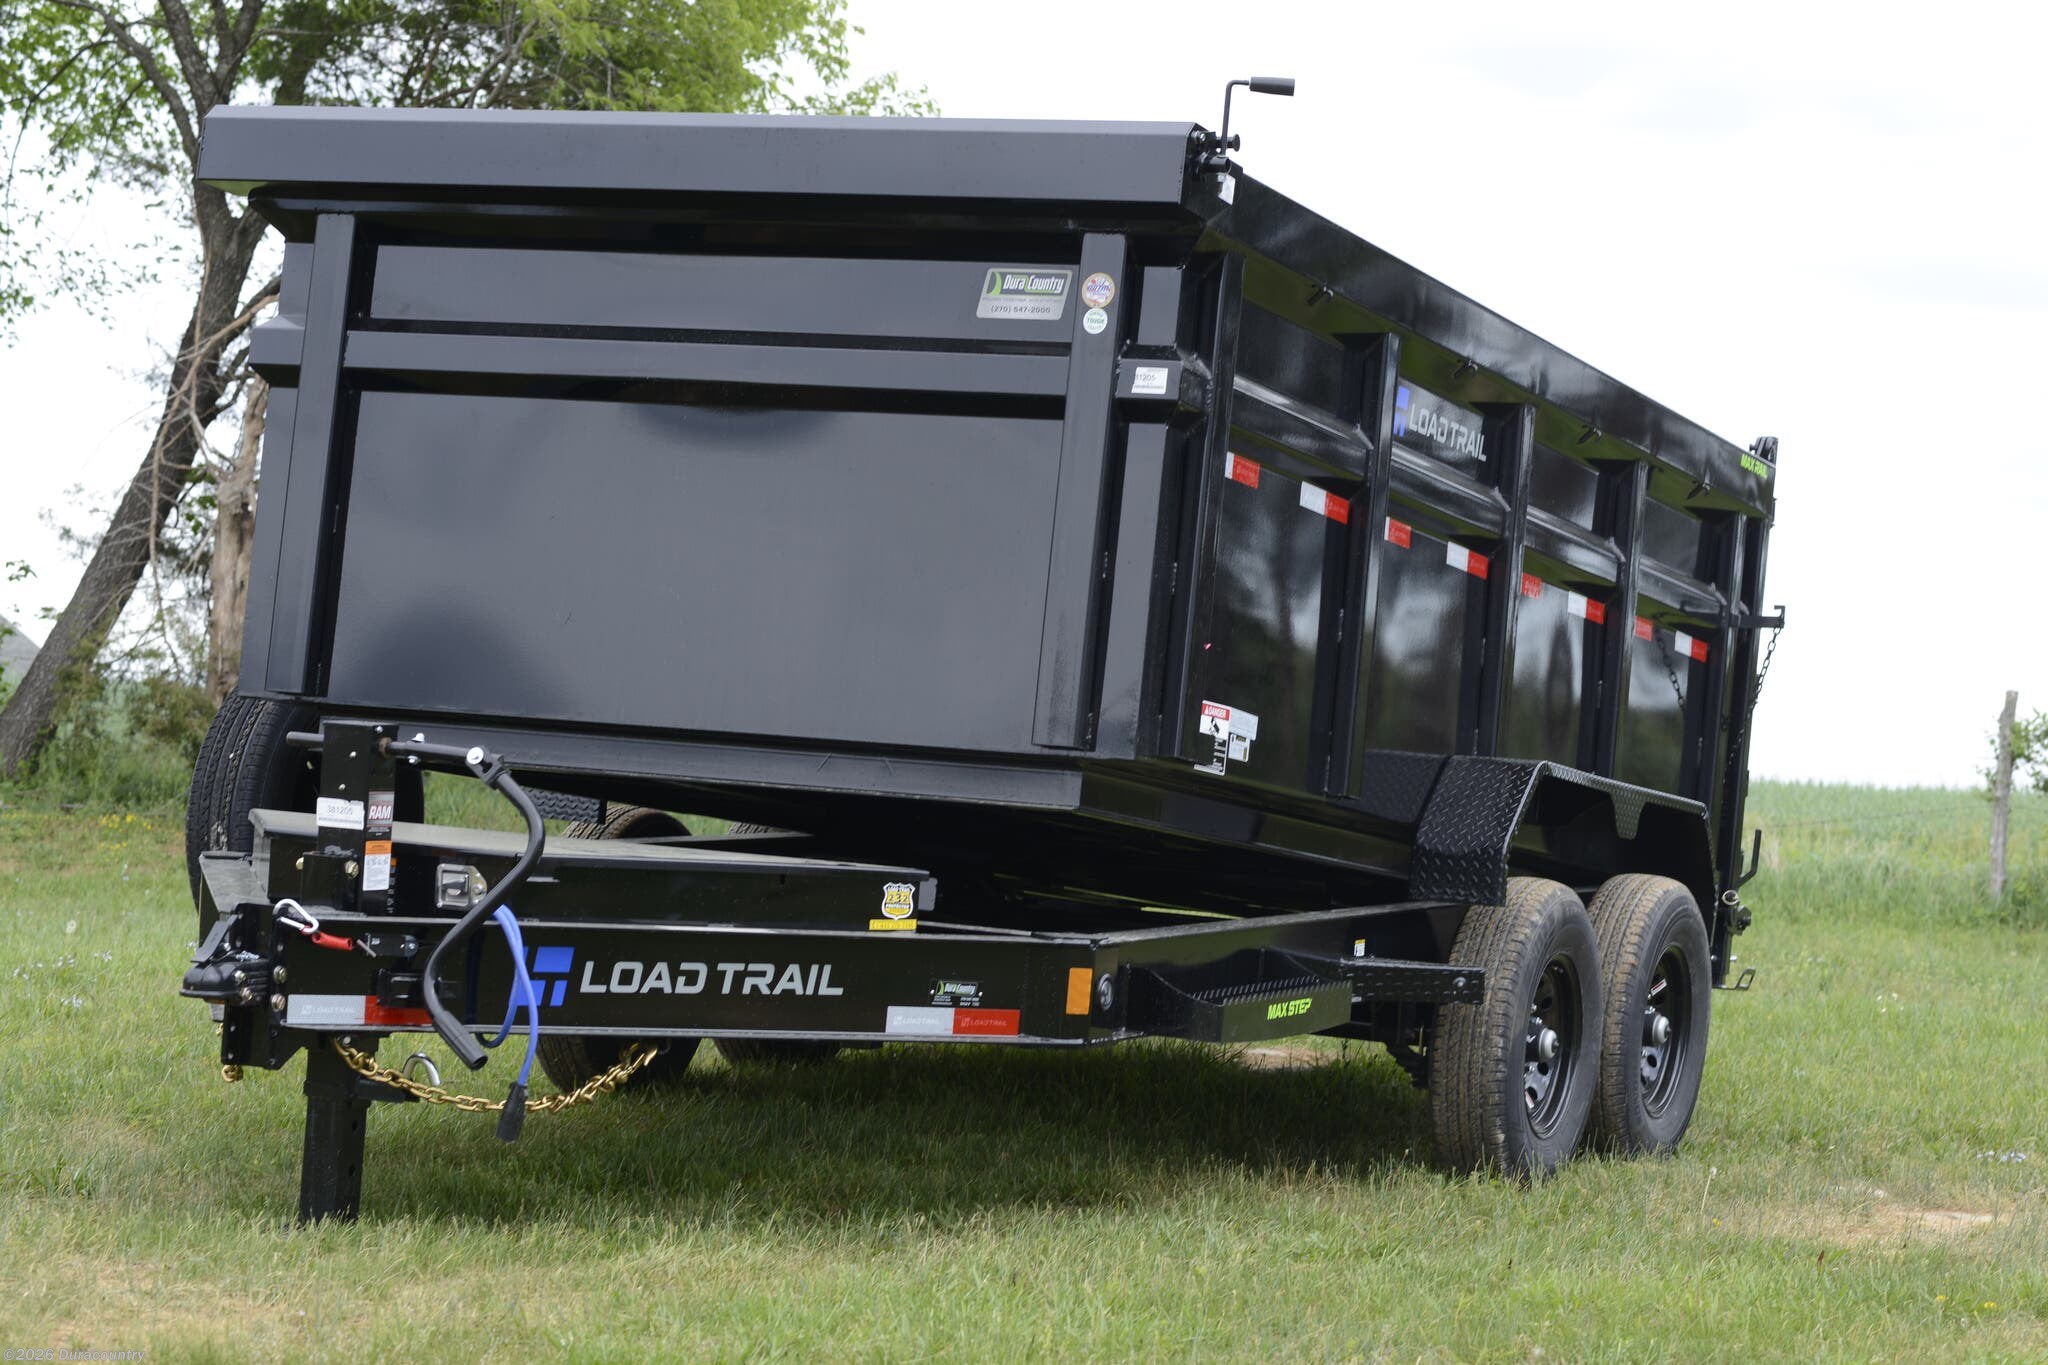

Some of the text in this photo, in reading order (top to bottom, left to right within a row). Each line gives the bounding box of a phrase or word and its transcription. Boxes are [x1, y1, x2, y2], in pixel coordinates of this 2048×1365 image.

[1003, 274, 1065, 294] Dura Country
[1409, 403, 1487, 462] LOAD TRAIL
[368, 805, 392, 820] RAM
[579, 961, 844, 996] LOAD TRAIL
[1267, 998, 1313, 1020] MAX STEP
